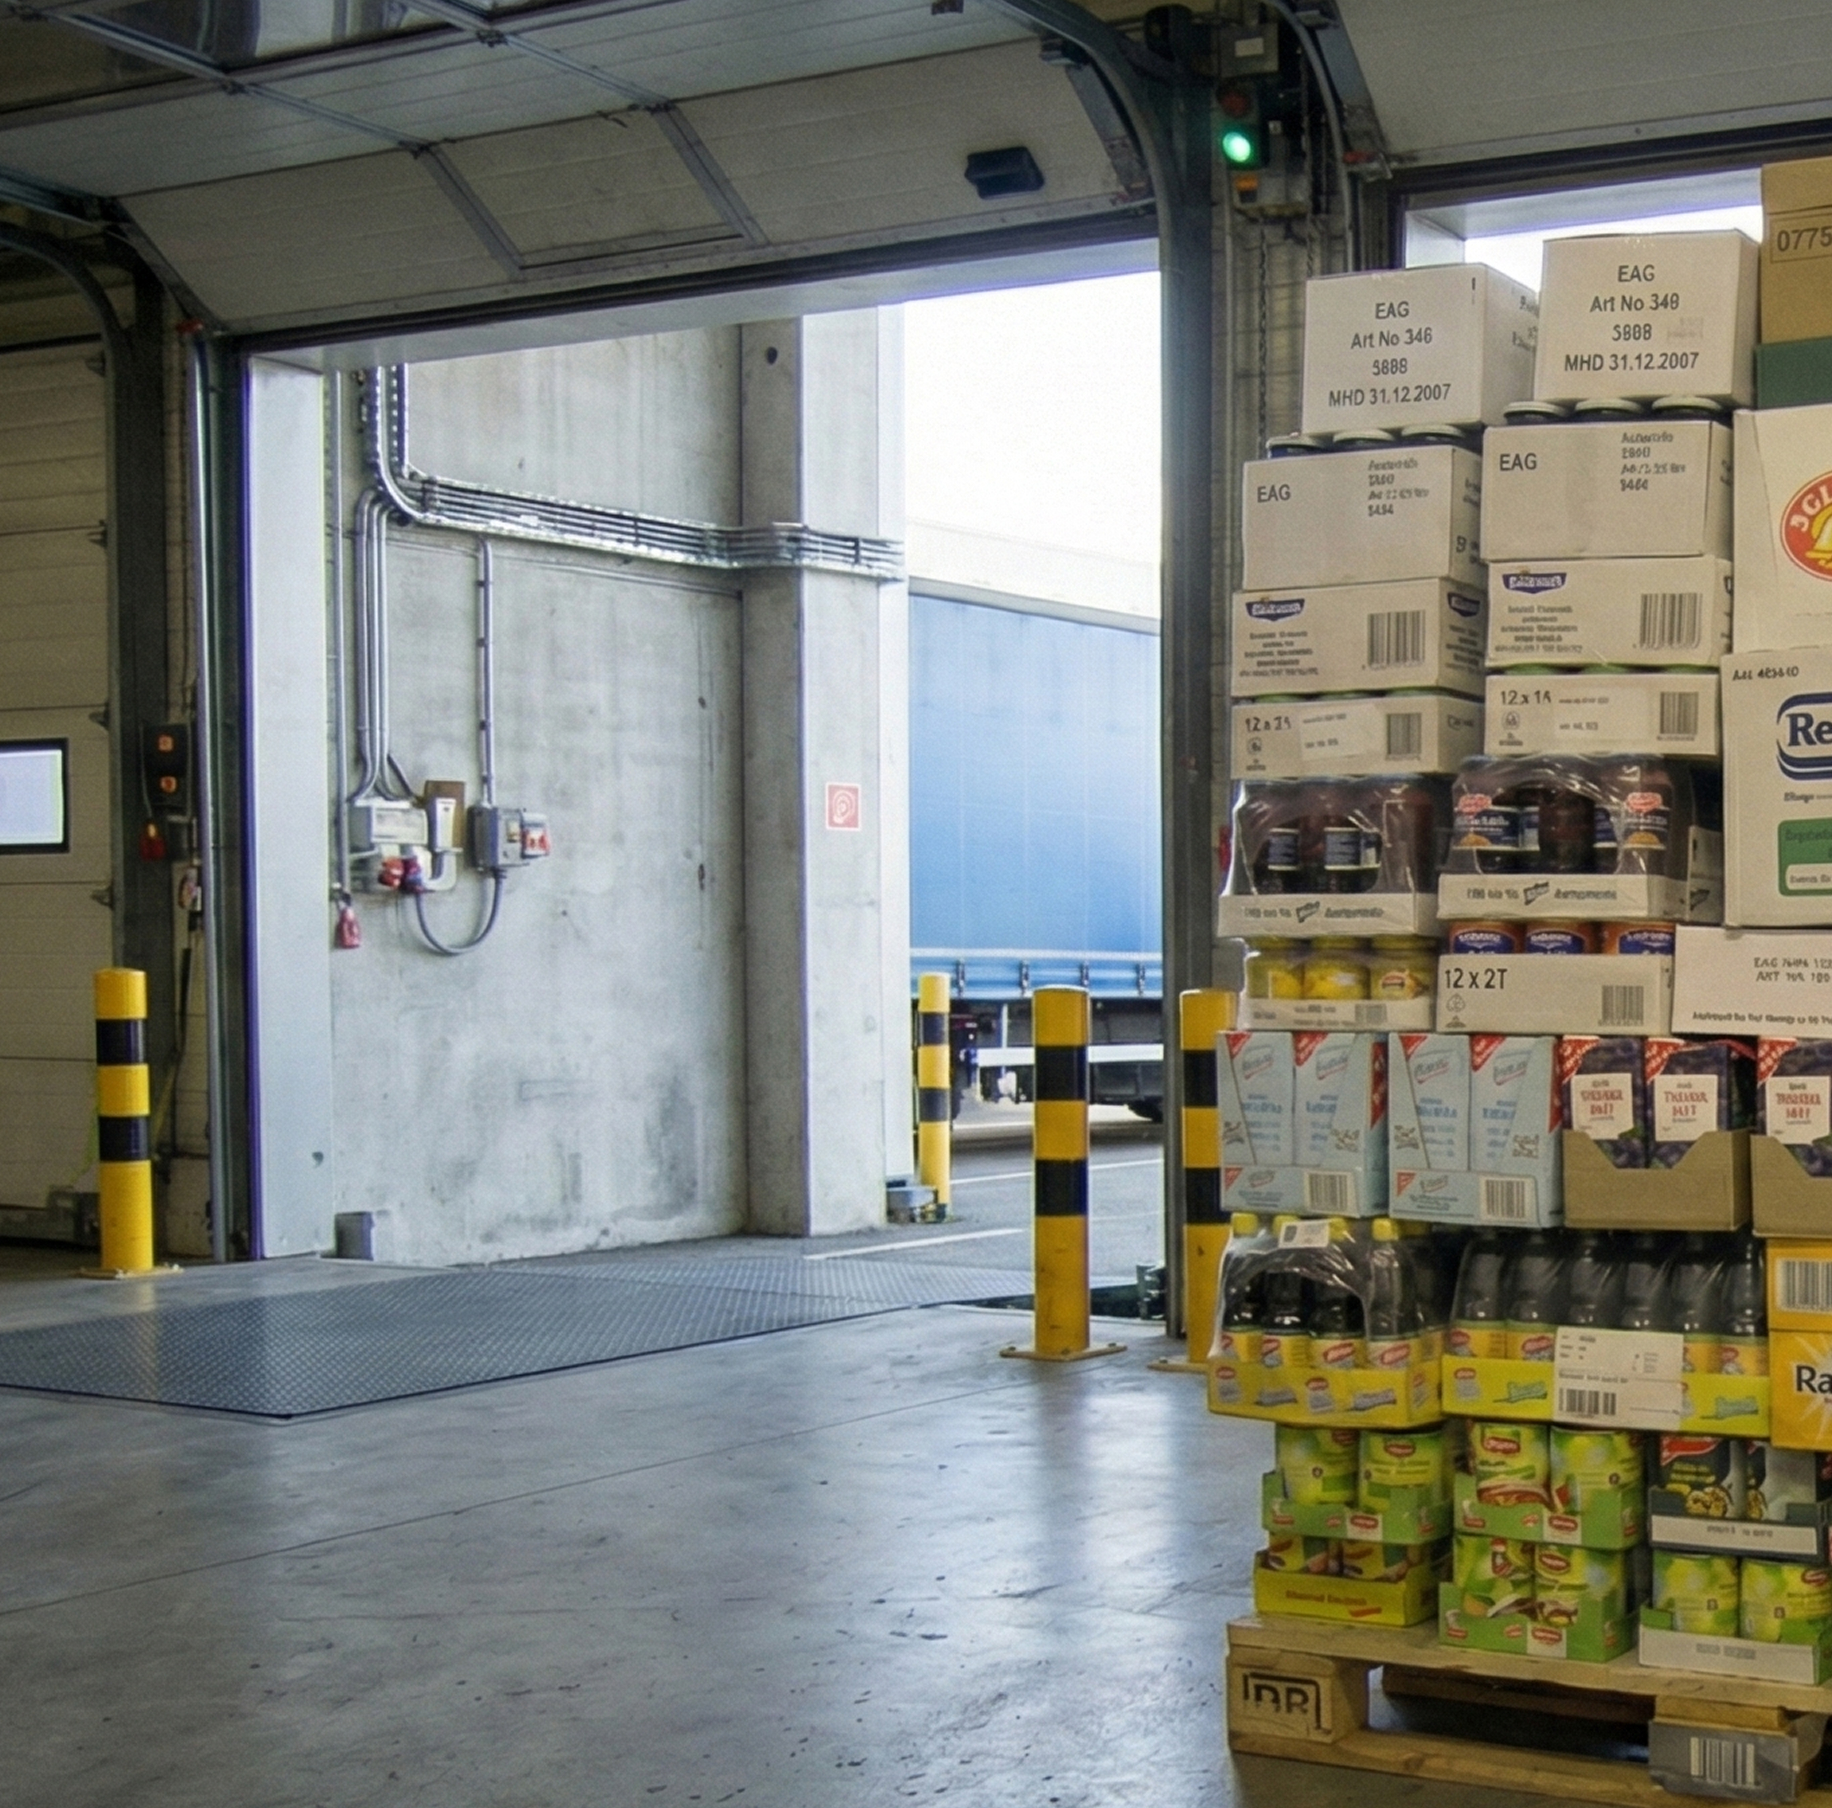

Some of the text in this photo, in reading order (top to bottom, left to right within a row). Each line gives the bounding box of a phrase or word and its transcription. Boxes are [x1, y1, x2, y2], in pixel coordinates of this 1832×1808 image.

[1618, 264, 1656, 283] EAG
[1375, 301, 1410, 320] EAG
[1621, 294, 1645, 312] No
[1351, 332, 1376, 350] Art
[1379, 330, 1400, 347] No
[1564, 353, 1605, 372] MHD
[1328, 387, 1366, 407] MHD
[1499, 452, 1538, 472] EAG
[1257, 483, 1292, 503] EAG
[1445, 967, 1465, 990] 12
[1468, 971, 1480, 989] x
